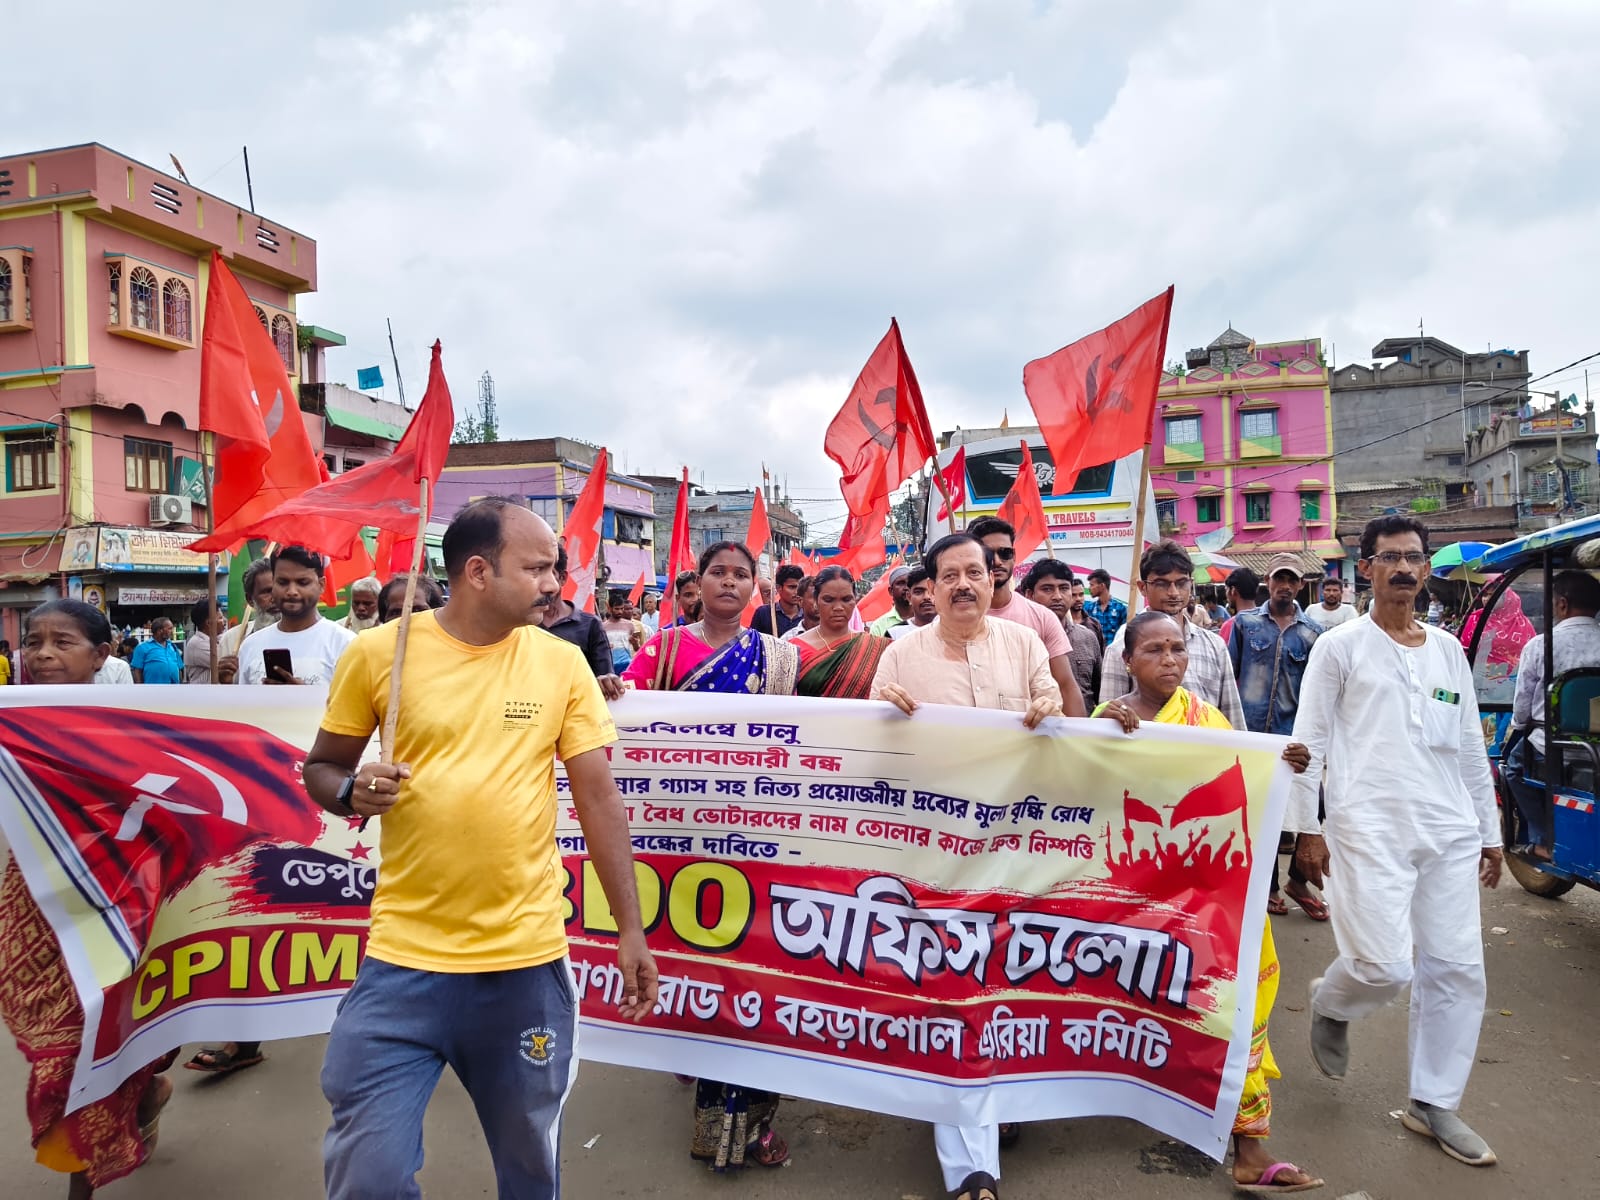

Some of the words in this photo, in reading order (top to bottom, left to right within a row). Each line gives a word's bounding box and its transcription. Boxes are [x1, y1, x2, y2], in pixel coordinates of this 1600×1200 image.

[1053, 512, 1096, 524] TRAVELS
[623, 746, 790, 769] কালোবাজারী
[799, 754, 842, 772] বন্ধ
[747, 723, 801, 744] চালু
[659, 778, 708, 794] গ্যাস
[715, 780, 747, 797] সহ
[754, 775, 802, 798] নিত্য
[808, 780, 907, 807] প্রয়োজনীয়
[912, 790, 970, 819] দ্রব্যের
[1051, 805, 1095, 824] রোধ
[643, 801, 685, 823] বৈধ
[693, 804, 802, 831] ভোটারদের
[809, 814, 848, 834] নাম
[855, 818, 932, 848] তোলার
[937, 831, 988, 857] কাজে
[702, 833, 780, 858] দাবিতে
[563, 859, 755, 954] DO
[768, 875, 998, 986] অফিস
[132, 929, 361, 1021] CPI(M
[733, 992, 763, 1029] ও
[1061, 1008, 1173, 1070] কমিটি
